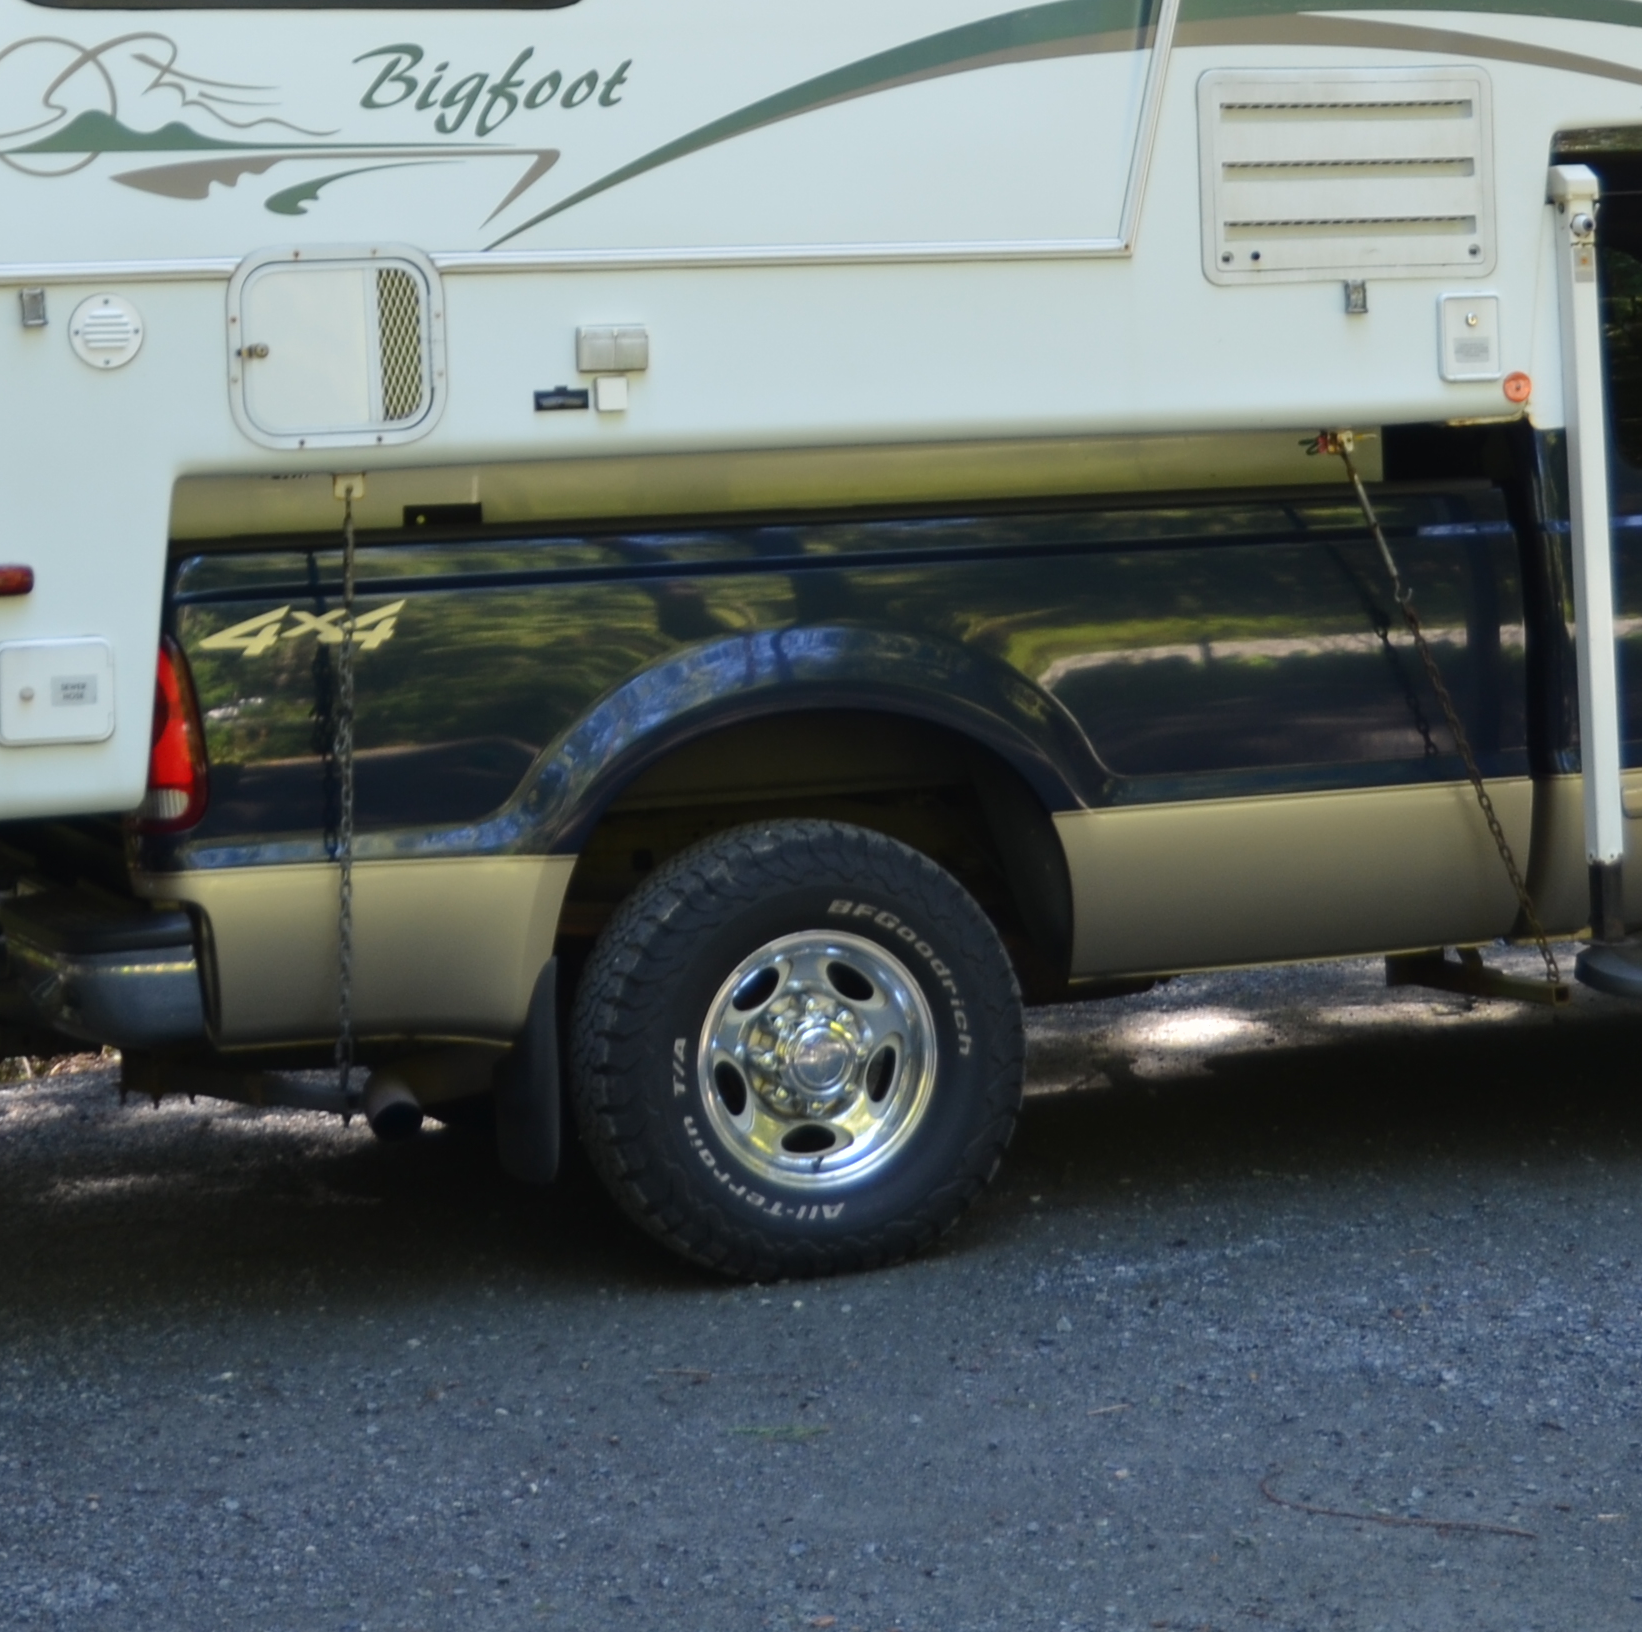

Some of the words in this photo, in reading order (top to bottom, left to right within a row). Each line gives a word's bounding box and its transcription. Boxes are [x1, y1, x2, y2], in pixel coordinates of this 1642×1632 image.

[352, 43, 633, 137] Bigfoot
[827, 899, 972, 1056] BFGoodrich
[673, 1038, 686, 1097] T/A
